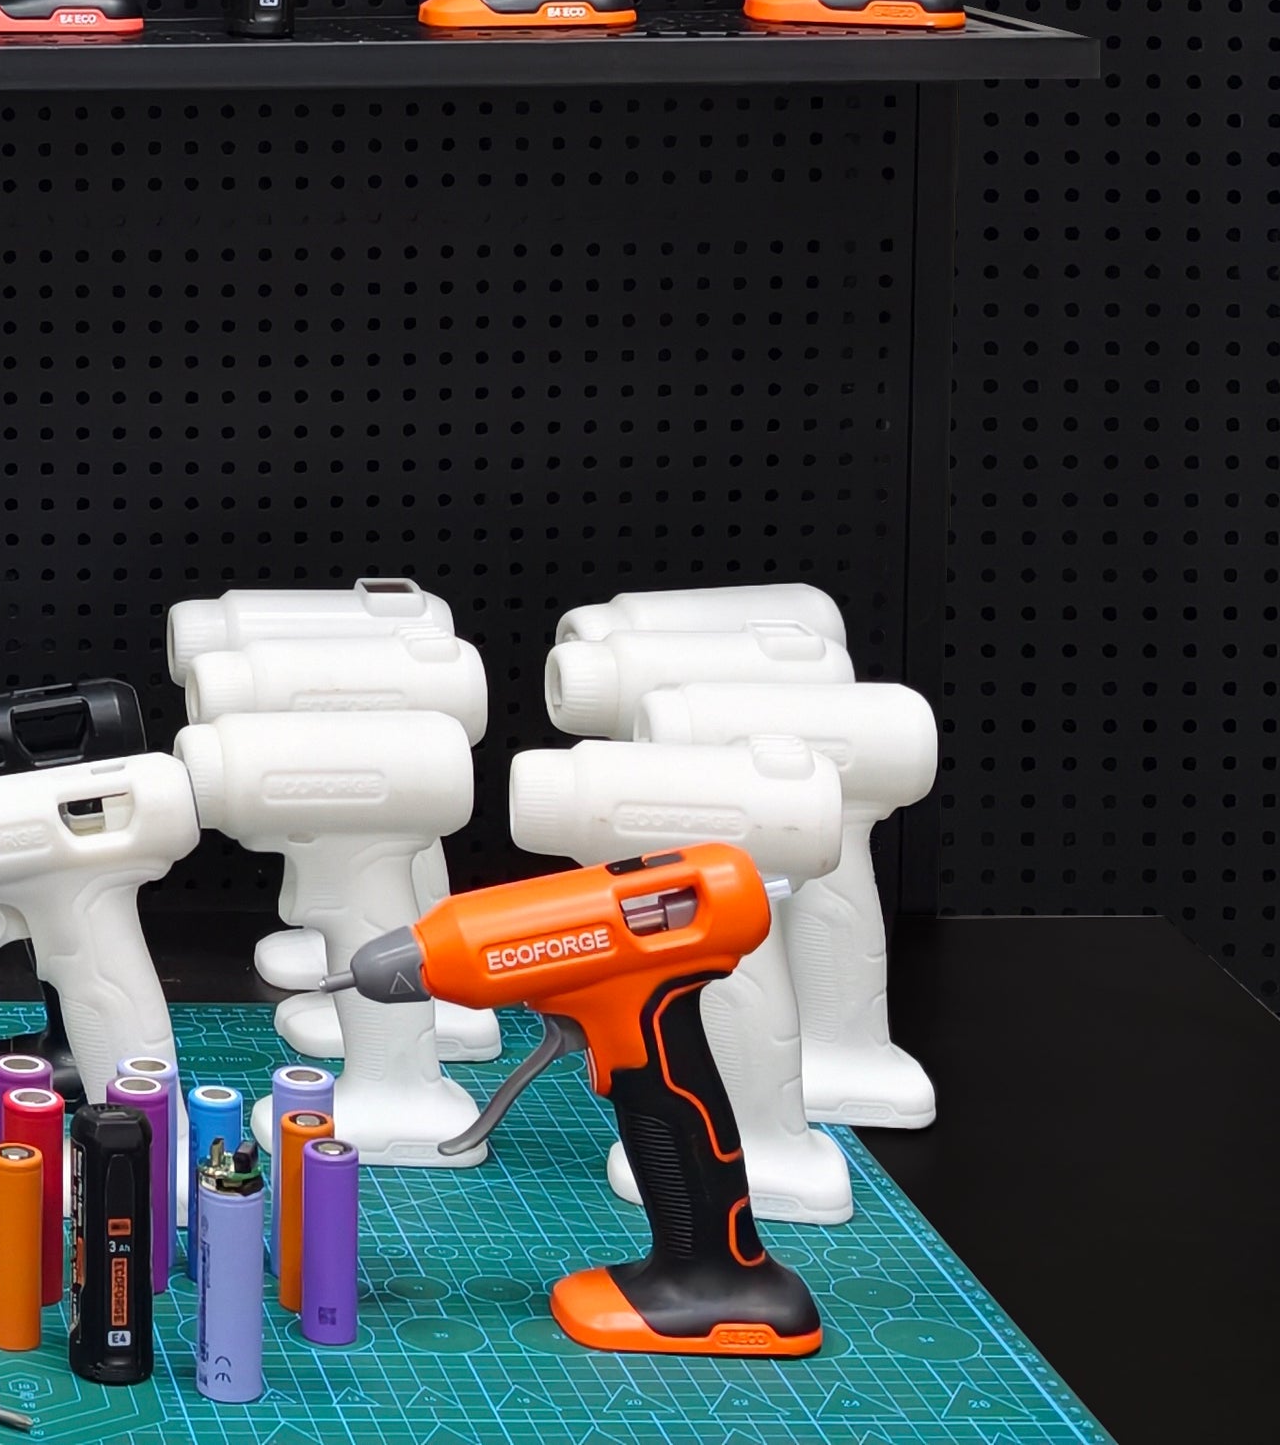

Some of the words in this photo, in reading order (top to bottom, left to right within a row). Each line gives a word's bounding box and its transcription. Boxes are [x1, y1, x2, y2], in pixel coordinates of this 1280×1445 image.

[563, 7, 586, 18] ECO
[75, 14, 97, 24] ECO
[487, 929, 610, 971] ECOFORGE
[109, 1241, 117, 1252] 3
[119, 1244, 130, 1252] Ah
[112, 1334, 126, 1343] E4
